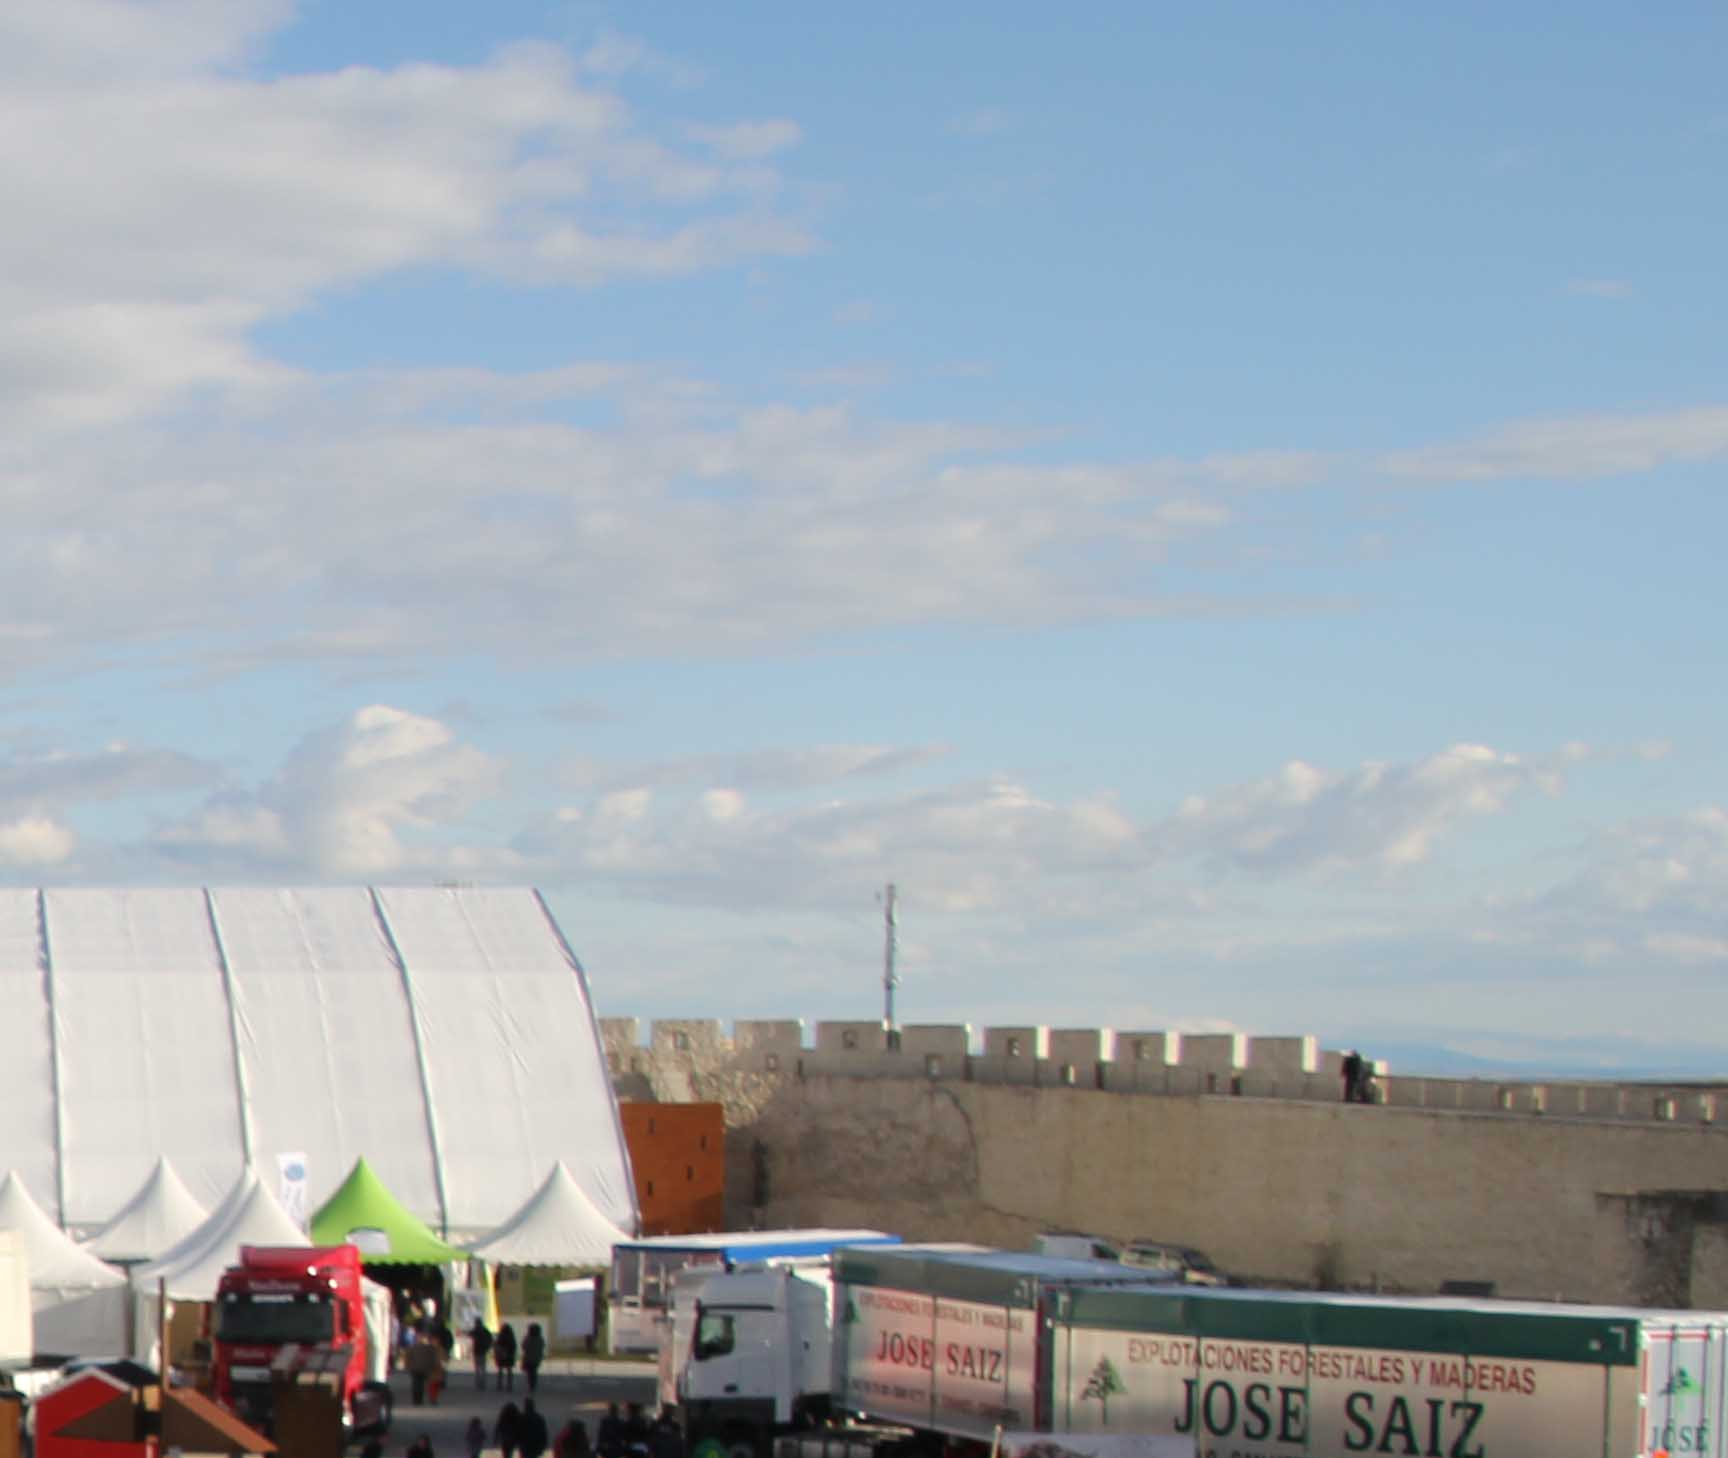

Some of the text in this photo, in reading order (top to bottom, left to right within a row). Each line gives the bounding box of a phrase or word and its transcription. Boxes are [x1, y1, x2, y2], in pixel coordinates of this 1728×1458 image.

[877, 1329, 1003, 1382] JOSE SAIZ
[1128, 1339, 1536, 1395] EXPLOTACIONES FORESTALES Y MADERAS
[1174, 1378, 1310, 1443] JOSE
